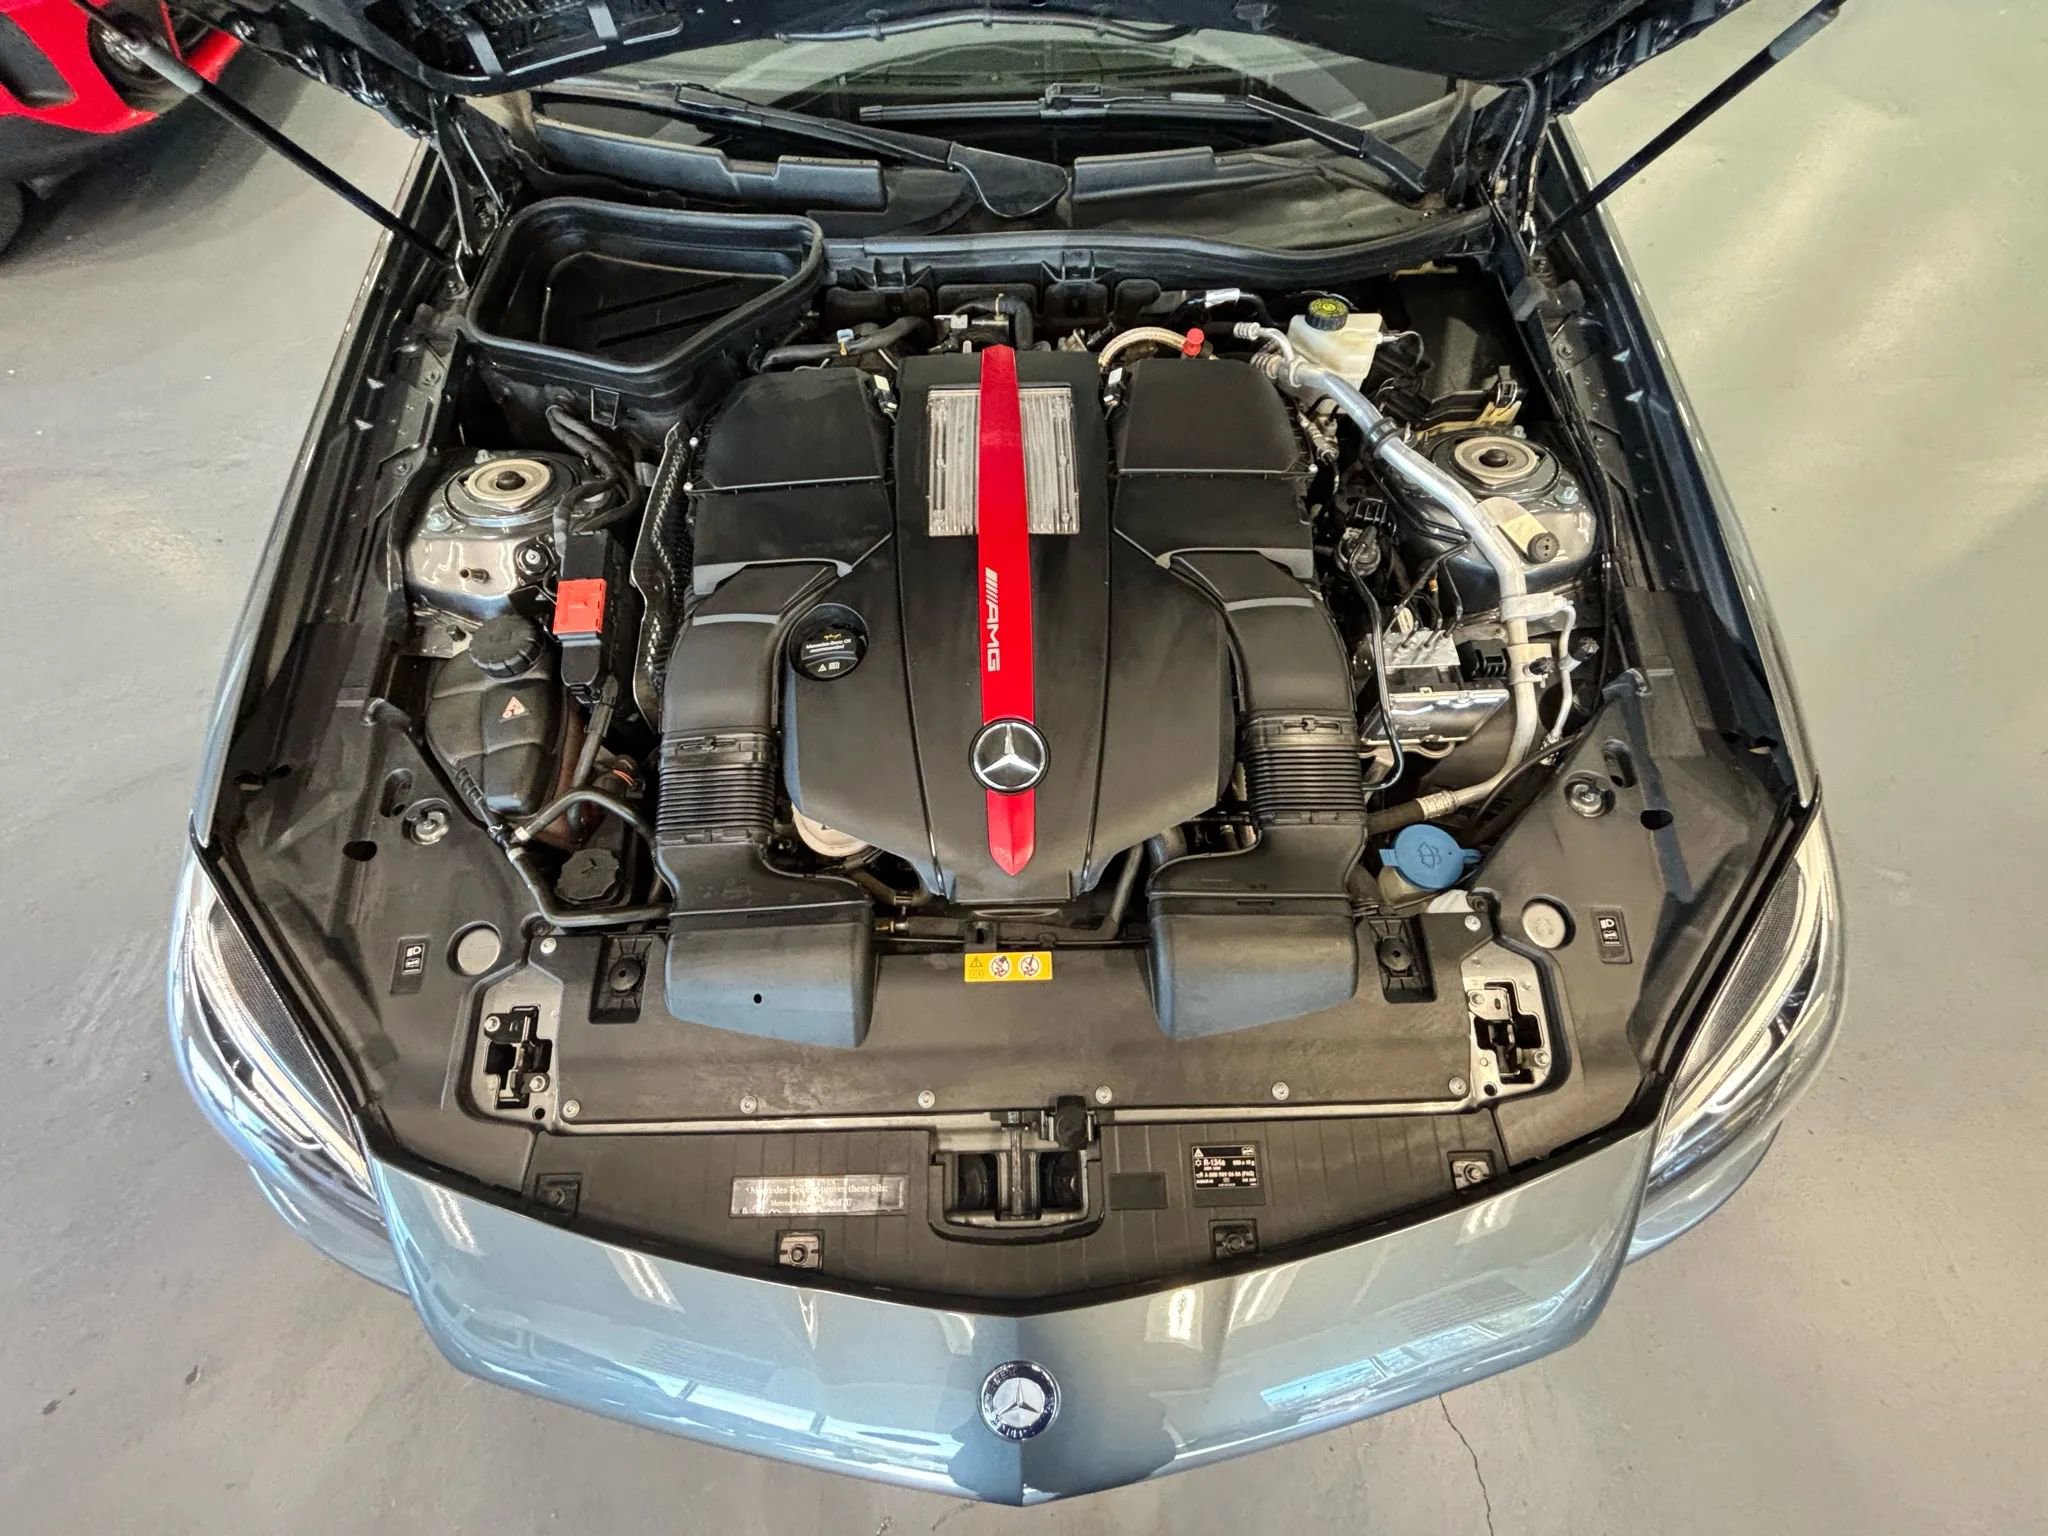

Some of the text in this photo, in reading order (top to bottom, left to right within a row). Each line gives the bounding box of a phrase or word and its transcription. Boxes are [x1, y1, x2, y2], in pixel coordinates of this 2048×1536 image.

[986, 599, 1001, 672] AMG
[750, 1184, 812, 1195] Medes-Be
[848, 1184, 870, 1193] these
